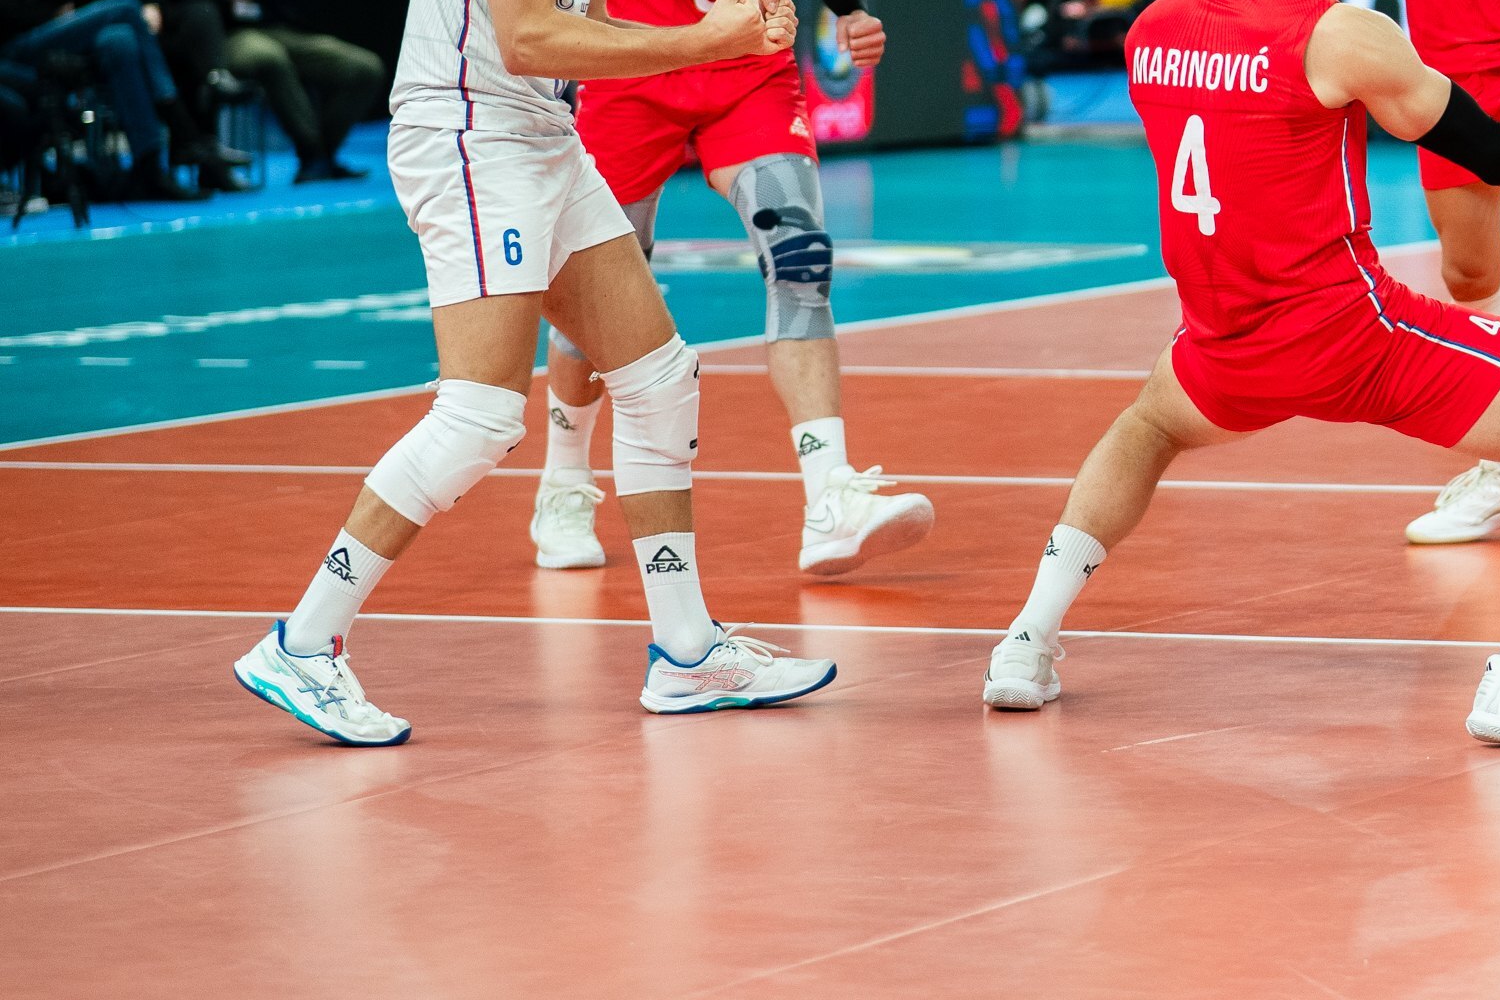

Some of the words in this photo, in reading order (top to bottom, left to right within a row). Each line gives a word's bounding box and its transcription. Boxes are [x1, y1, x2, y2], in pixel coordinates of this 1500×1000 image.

[1133, 46, 1269, 93] MARINOVIĆ
[1171, 114, 1221, 236] 4
[502, 228, 523, 266] 6
[323, 555, 359, 586] PEAK
[646, 561, 689, 574] PEAK
